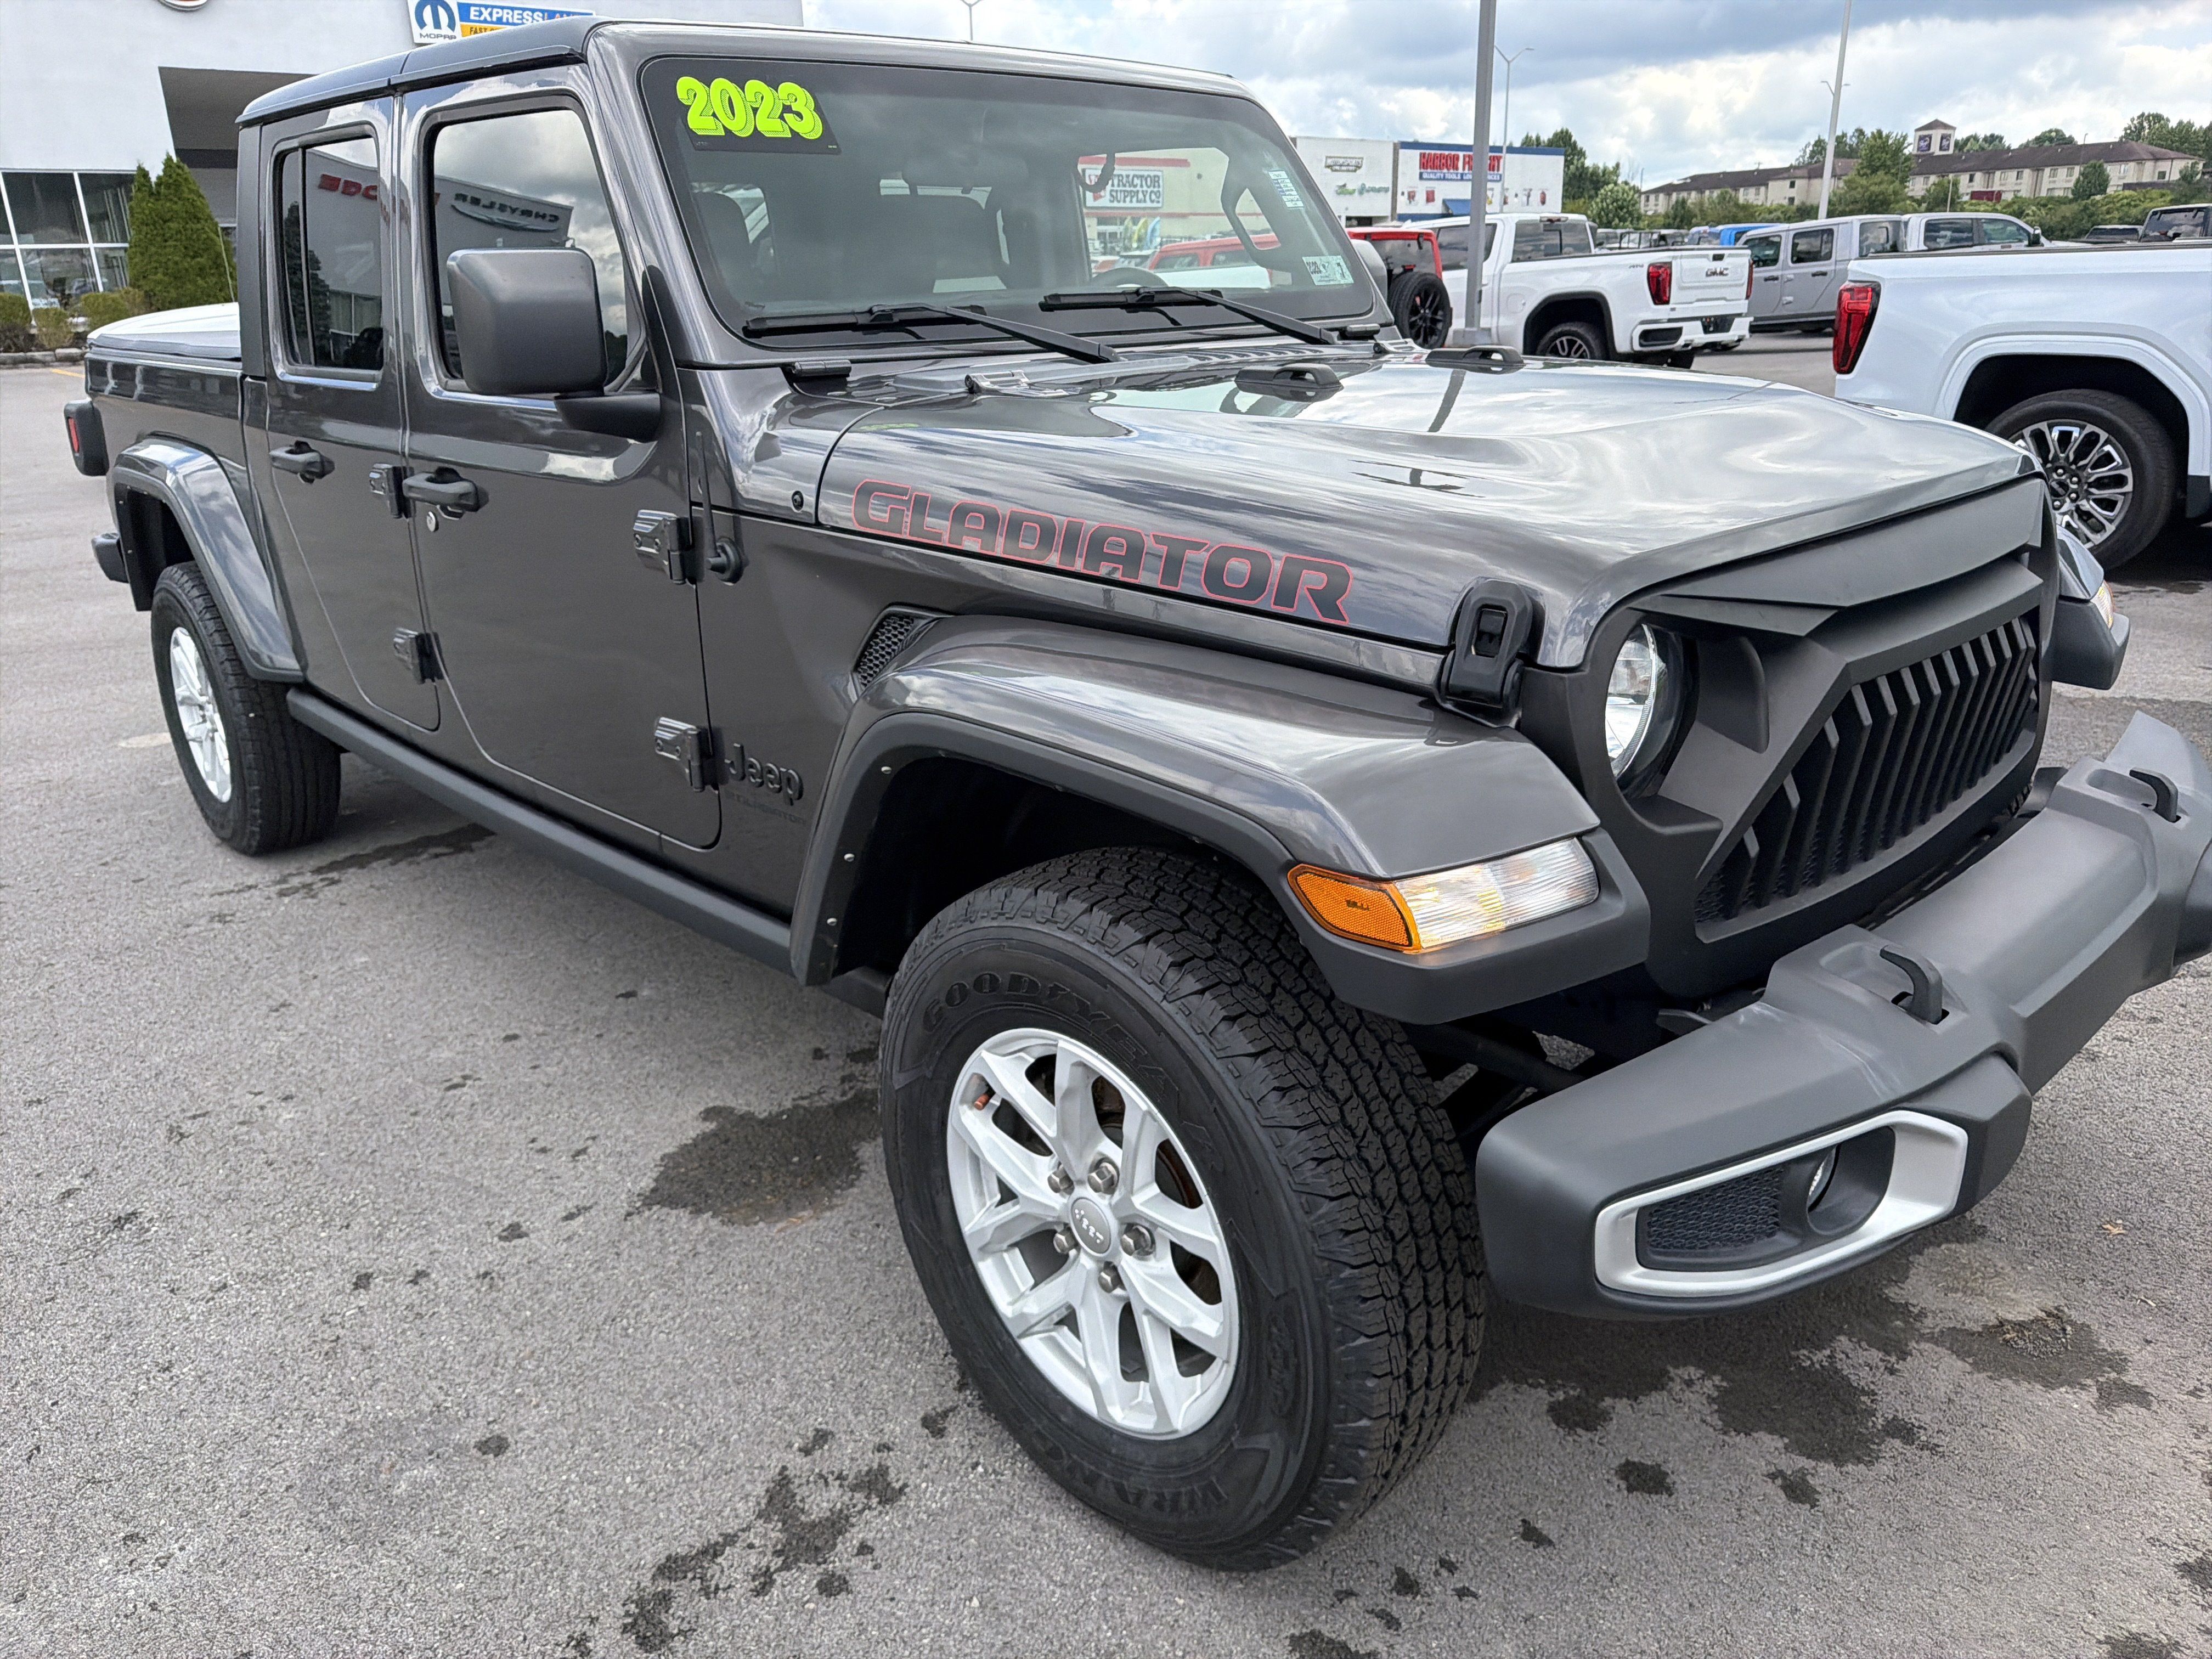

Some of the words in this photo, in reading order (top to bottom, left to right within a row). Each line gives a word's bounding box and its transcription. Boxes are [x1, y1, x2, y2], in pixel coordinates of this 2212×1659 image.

[676, 76, 822, 139] 2023
[1419, 152, 1460, 171] HARBOR
[1462, 154, 1502, 172] FRHT
[1111, 174, 1160, 188] TRACTOR
[1109, 189, 1148, 203] SUPPLY
[1706, 267, 1729, 277] GMC
[852, 479, 1353, 625] GLADIATOR
[725, 743, 804, 806] Jeep
